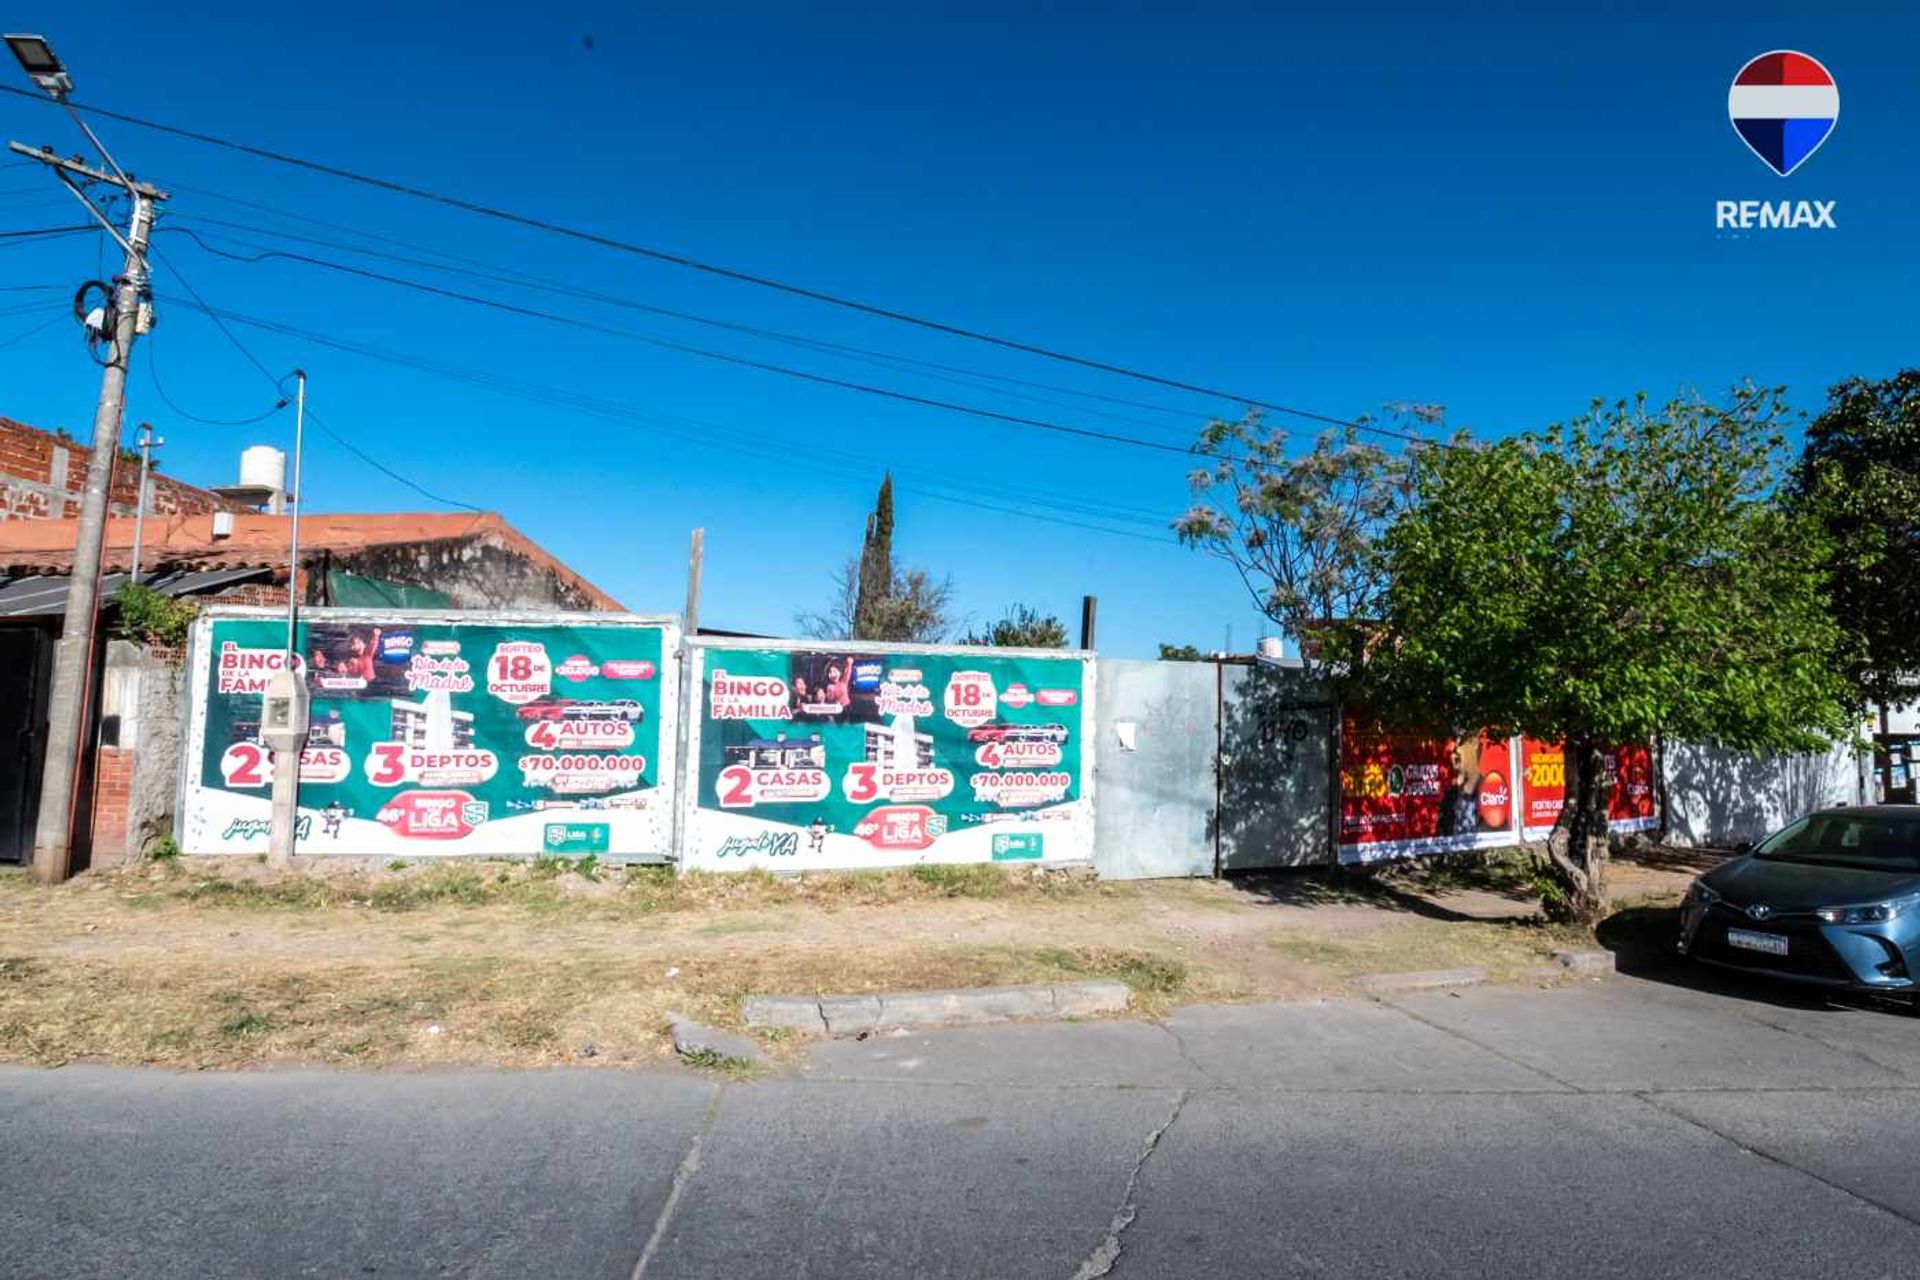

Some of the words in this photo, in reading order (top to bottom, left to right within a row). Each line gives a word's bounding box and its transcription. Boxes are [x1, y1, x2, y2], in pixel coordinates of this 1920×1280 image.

[223, 642, 237, 651] EL
[222, 653, 302, 670] BINGO
[495, 655, 533, 681] 18
[489, 684, 549, 693] OCTUBRE
[713, 681, 784, 696] BINGO
[950, 683, 981, 706] 18
[713, 704, 791, 717] FAMILIA
[531, 722, 556, 748] 4
[560, 722, 628, 735] AUTOS
[228, 745, 262, 784] 2
[372, 745, 404, 783] 3
[410, 754, 493, 768] DEPTOS
[520, 756, 643, 771] $70.000.000
[980, 743, 1001, 766] 4
[1003, 743, 1056, 755] AUTOS
[722, 767, 752, 804] 2
[757, 772, 822, 785] CASAS
[849, 765, 877, 801] 3
[882, 772, 949, 785] DEPTOS
[1481, 791, 1505, 806] Claro
[293, 815, 312, 841] A
[408, 811, 459, 829] LIGA
[882, 824, 923, 841] LIGA
